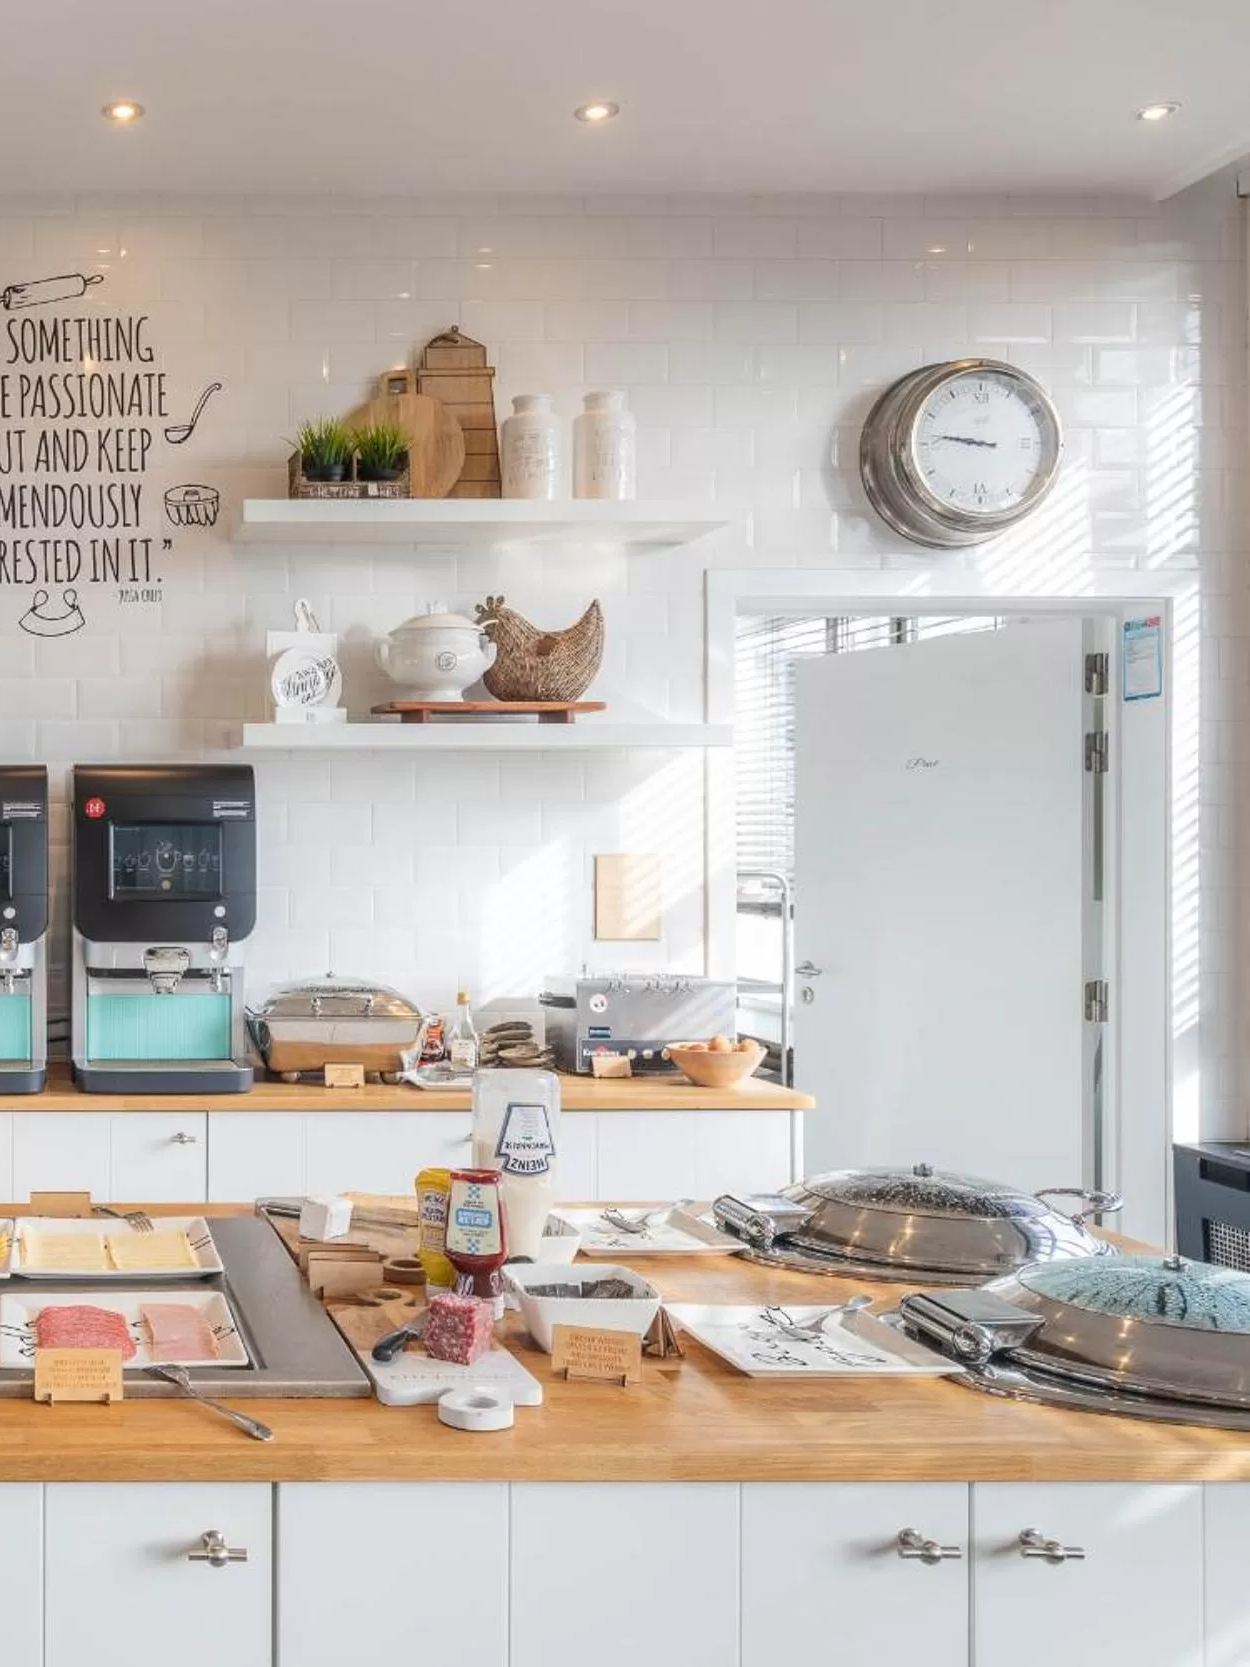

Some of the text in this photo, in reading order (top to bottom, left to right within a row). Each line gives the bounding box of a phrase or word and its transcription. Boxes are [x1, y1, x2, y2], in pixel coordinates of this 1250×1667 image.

[6, 316, 154, 364] SOMETHING
[19, 372, 169, 419] PASSIONATE
[34, 429, 89, 473] AND
[97, 428, 152, 473] KEEP
[89, 538, 120, 583] IN
[510, 1157, 545, 1171] HEINZ
